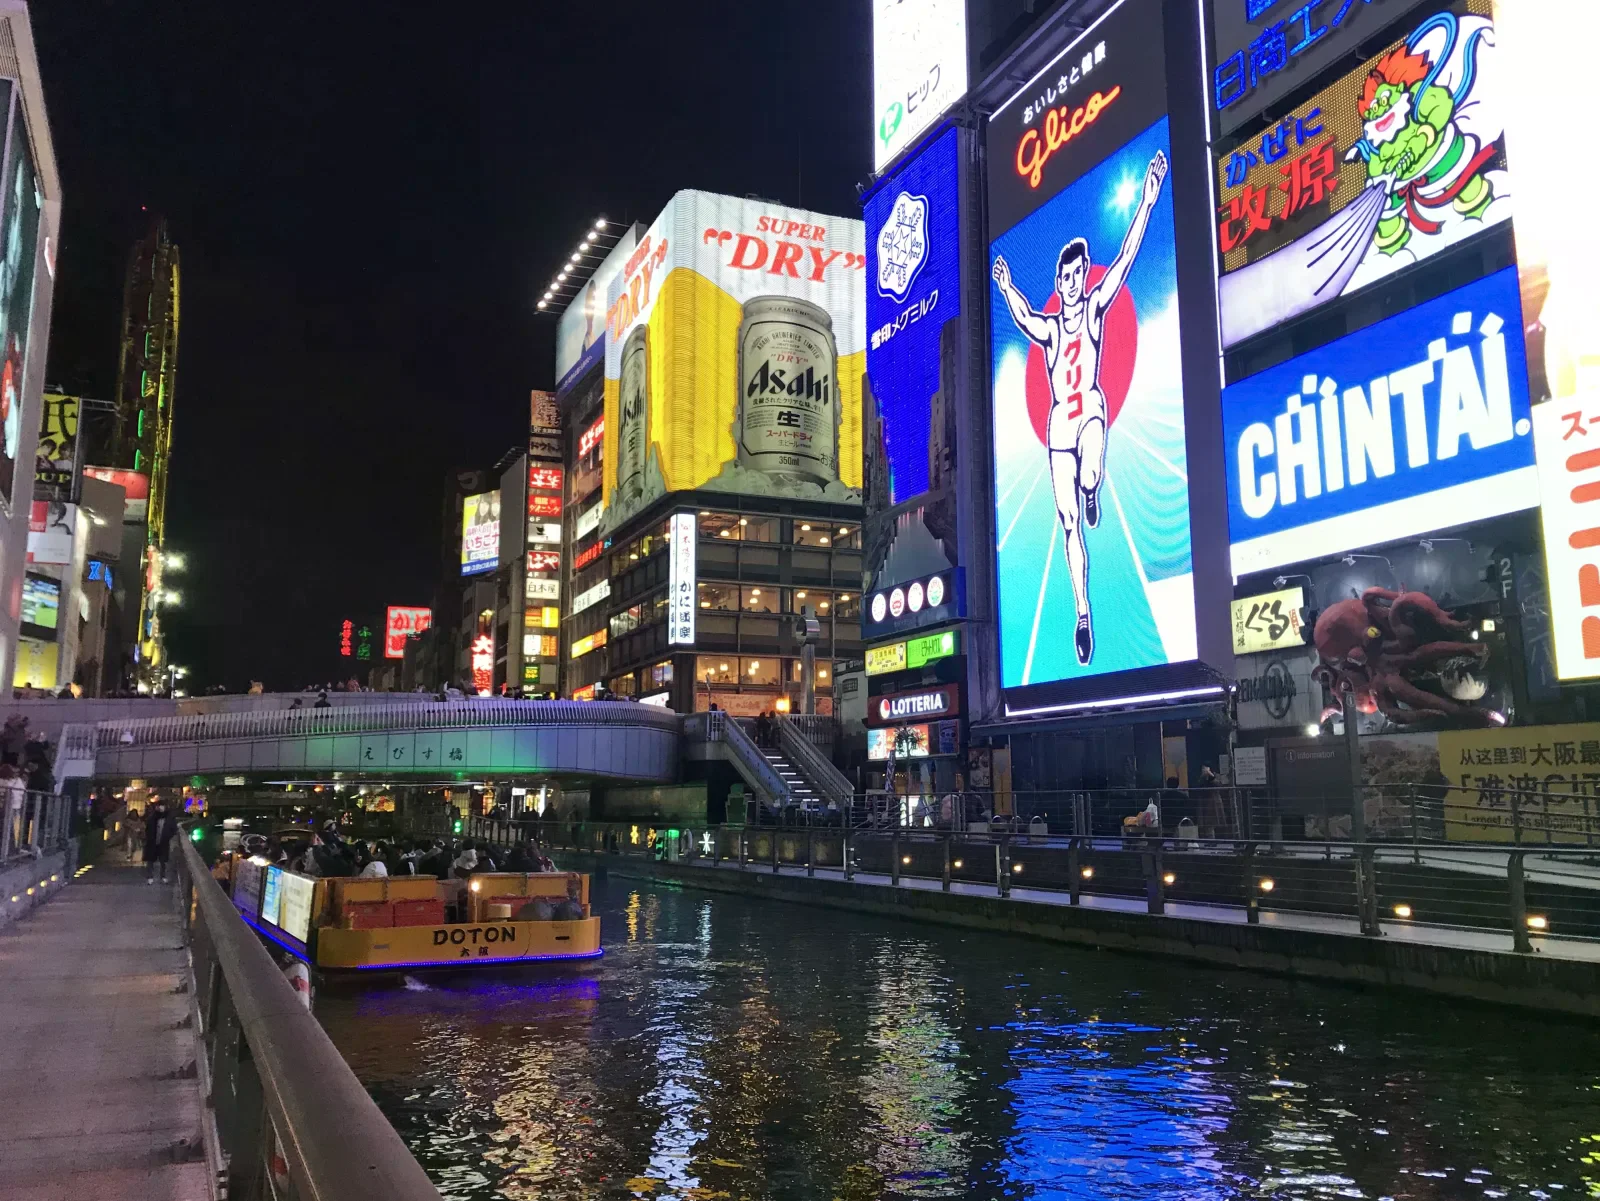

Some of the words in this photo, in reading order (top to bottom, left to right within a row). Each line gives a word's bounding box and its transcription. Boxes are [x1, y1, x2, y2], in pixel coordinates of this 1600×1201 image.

[1023, 40, 1107, 125] おいしさと健康
[1225, 107, 1325, 188] かぜに
[1218, 136, 1337, 253] 改源
[757, 216, 825, 242] SUPER
[870, 289, 938, 351] 雪印メグミルク
[748, 360, 829, 407] Asahi
[1064, 332, 1083, 420] グリコ
[777, 411, 801, 428] 生
[766, 430, 813, 442] スーパードライ
[779, 456, 800, 466] 350ml
[529, 504, 560, 515] ダイニング
[528, 583, 556, 595] 白木屋
[892, 694, 943, 715] LOTTERIA
[364, 747, 463, 761] えびす橋
[1297, 751, 1335, 760] information
[433, 927, 516, 946] DOTON
[460, 946, 489, 957] 大阪
